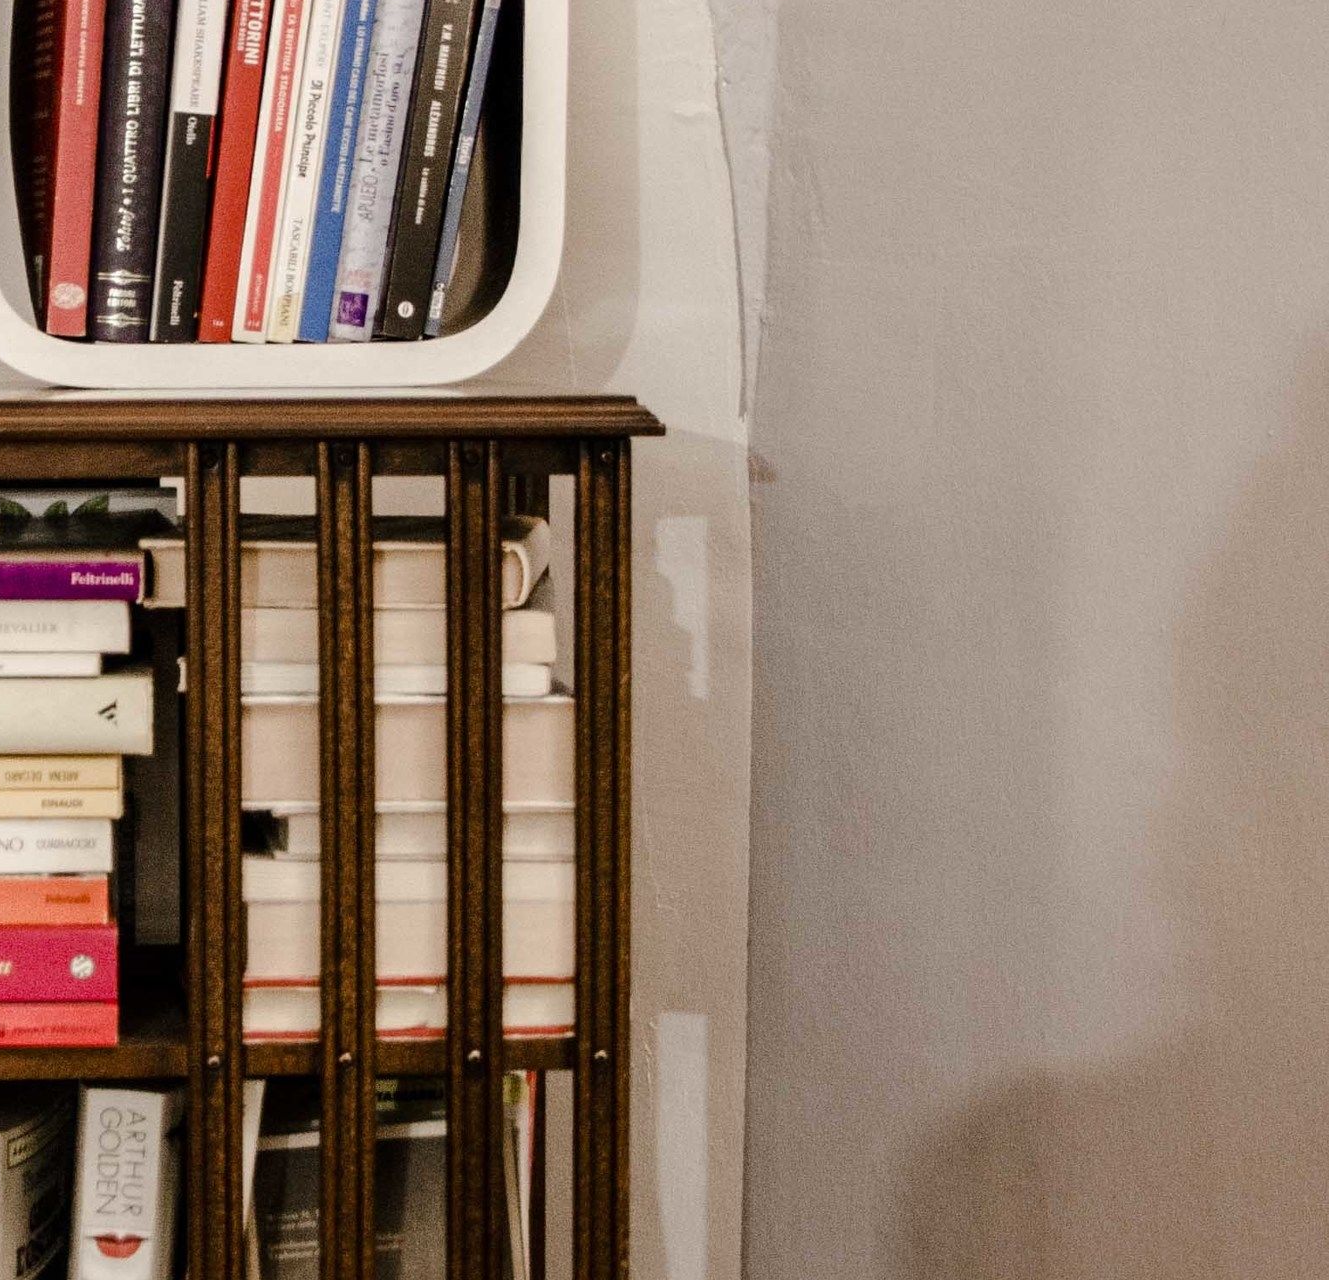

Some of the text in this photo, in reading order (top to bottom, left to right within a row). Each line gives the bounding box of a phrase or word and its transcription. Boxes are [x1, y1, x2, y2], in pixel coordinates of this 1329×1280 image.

[287, 13, 297, 26] LA
[128, 60, 142, 75] DI
[188, 27, 206, 107] SHAKESPEARE
[433, 44, 450, 90] MANFREDI
[126, 80, 141, 115] LIBRI
[272, 75, 288, 132] STAGIONATA
[366, 51, 389, 141] metamorfosi
[122, 119, 139, 183] QUATTRO
[184, 115, 198, 145] Otello
[296, 79, 322, 179] Il Piccolo Principe
[279, 216, 305, 327] TASCABILI BOMPIANI
[169, 279, 184, 326] Feltrinelli
[70, 571, 133, 584] Feltrinelli
[93, 1106, 123, 1215] GOLDEN
[121, 1109, 149, 1216] ARTHUR
